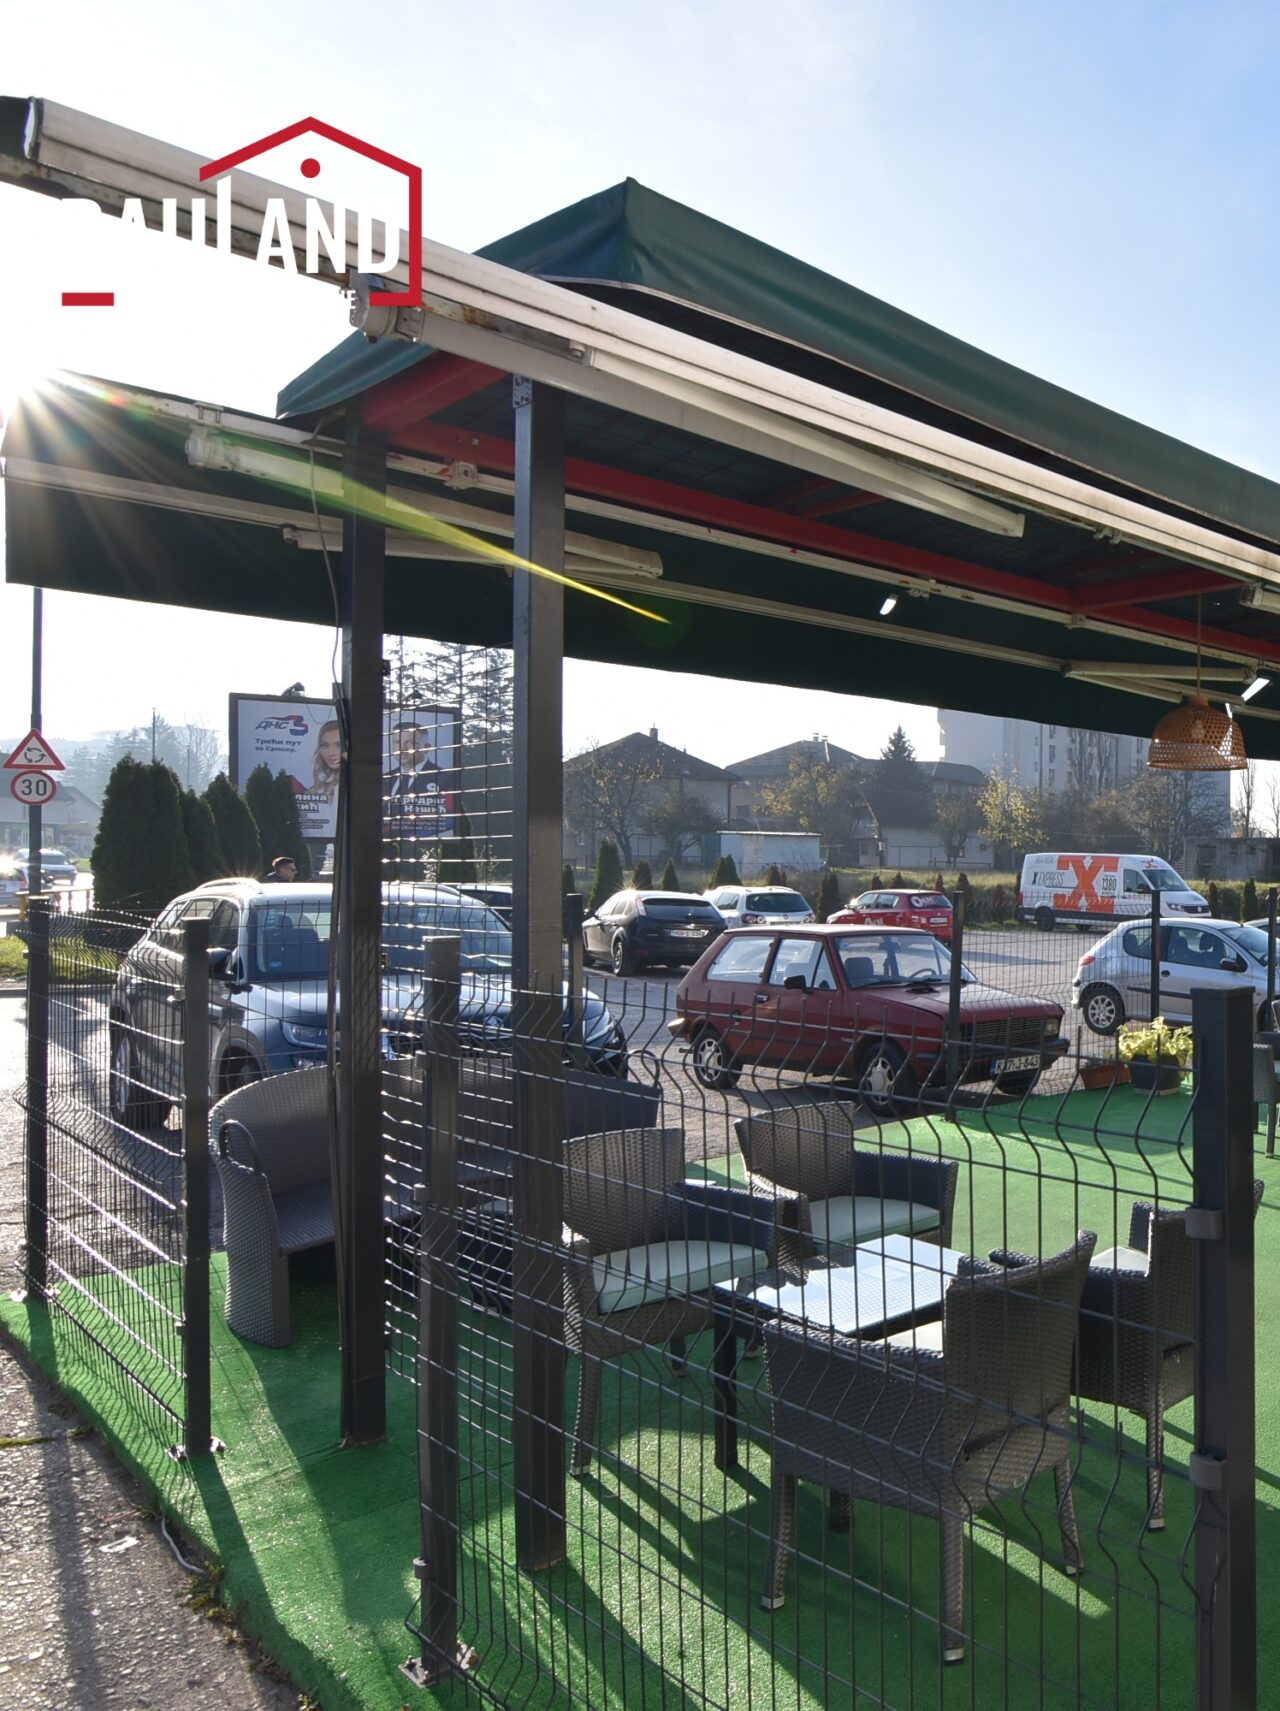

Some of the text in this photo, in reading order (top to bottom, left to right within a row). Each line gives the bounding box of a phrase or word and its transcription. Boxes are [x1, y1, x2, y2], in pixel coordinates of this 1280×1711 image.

[255, 720, 289, 730] ДНС
[21, 779, 47, 796] 30
[1032, 872, 1039, 885] X
